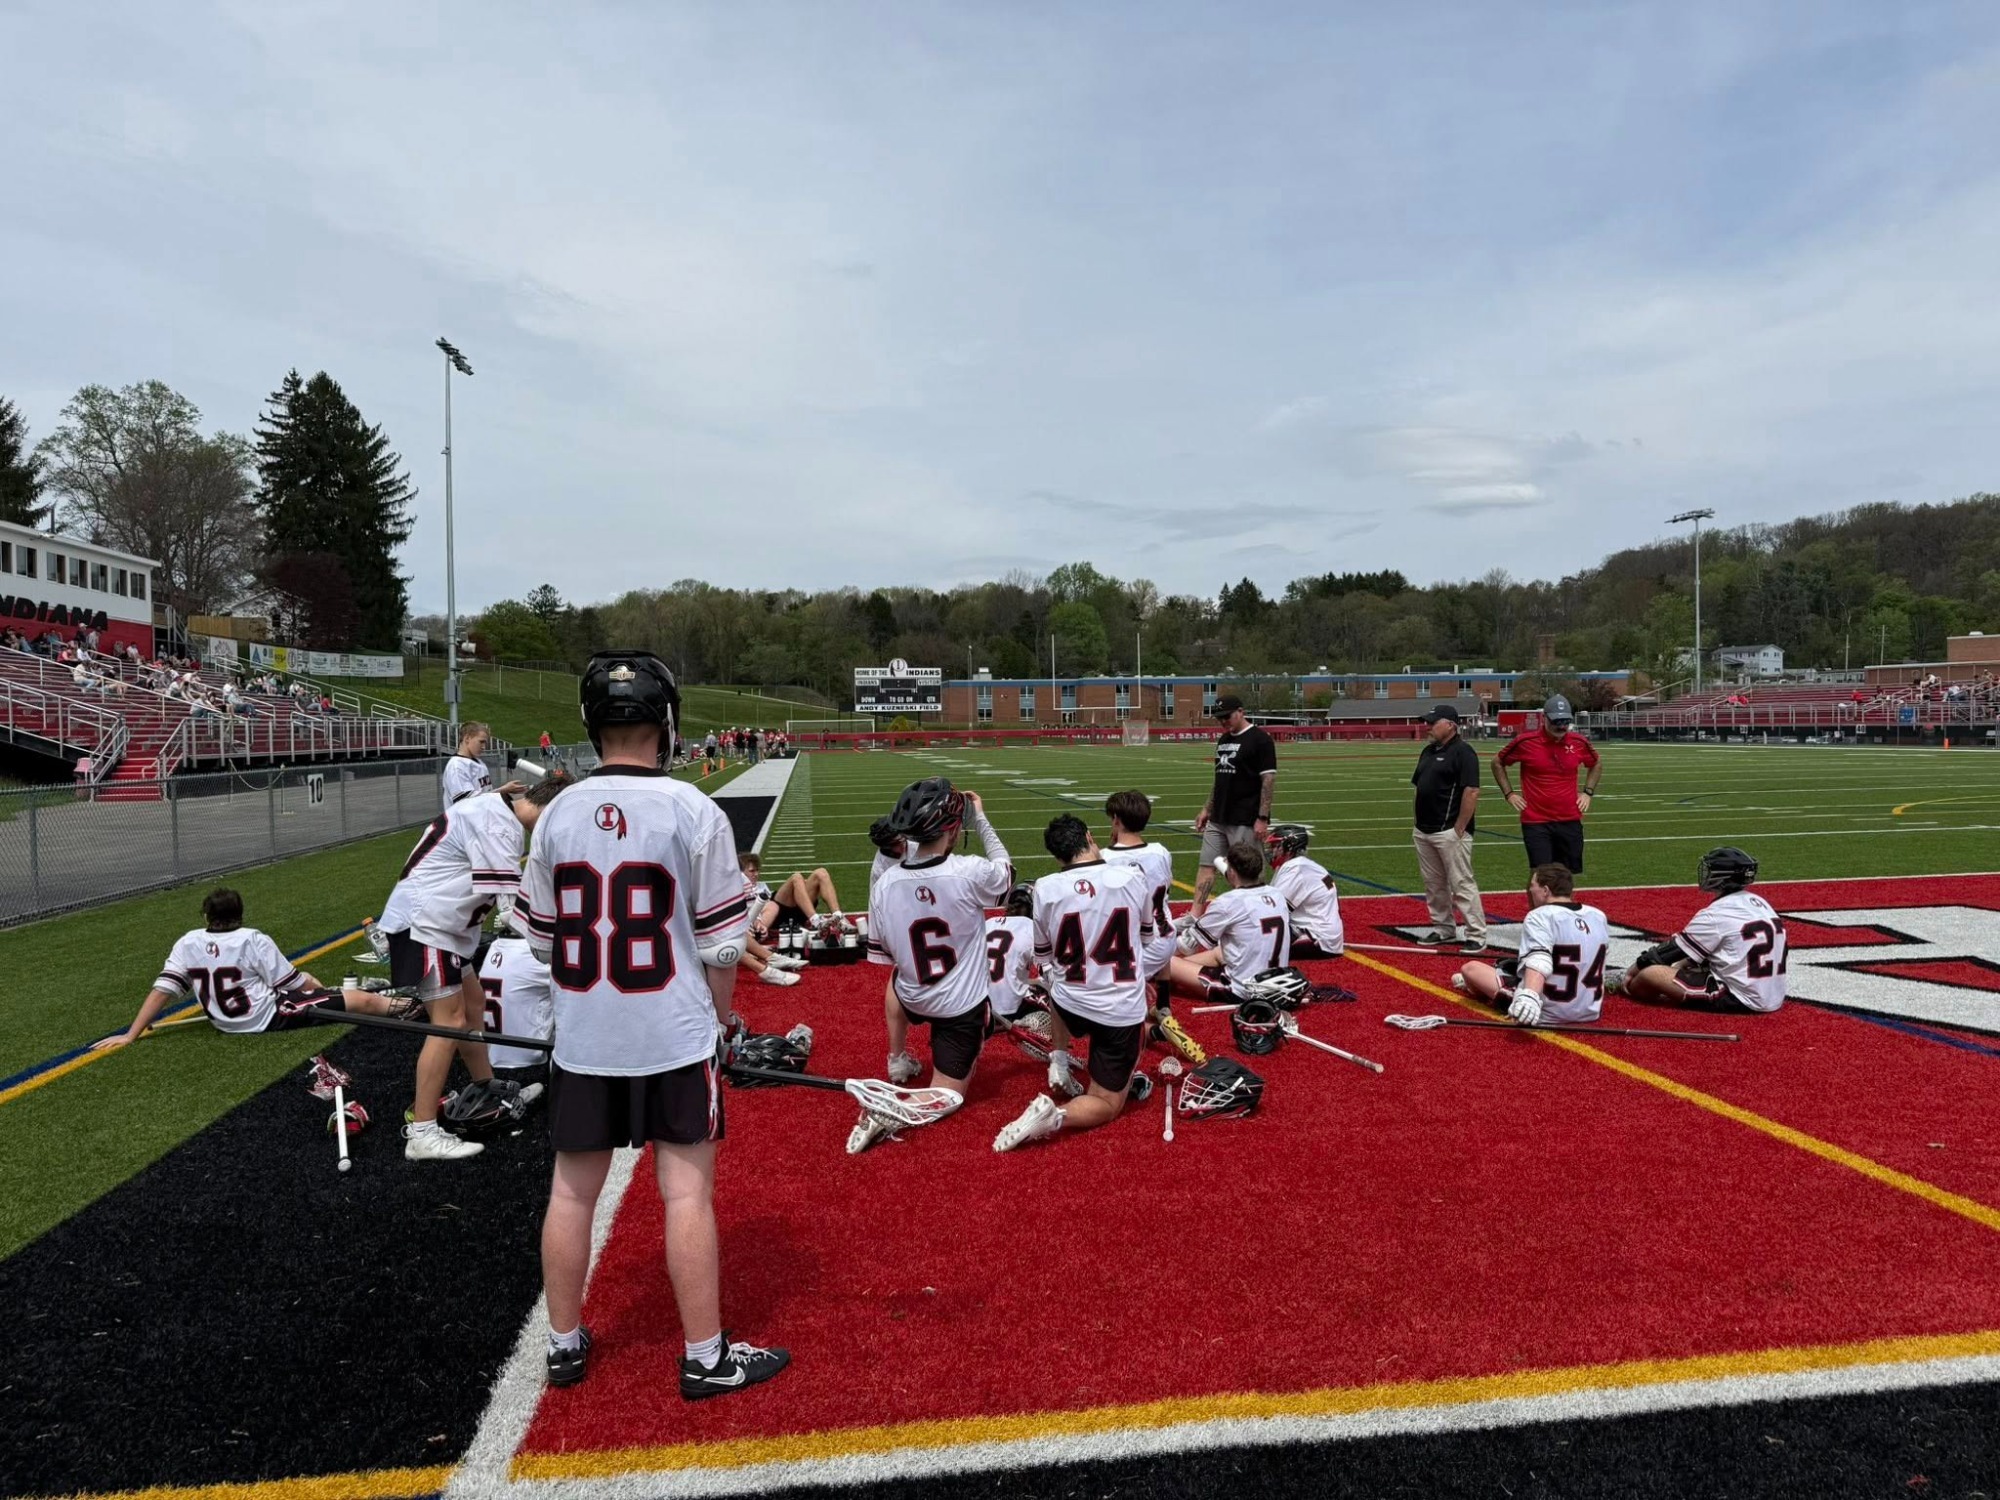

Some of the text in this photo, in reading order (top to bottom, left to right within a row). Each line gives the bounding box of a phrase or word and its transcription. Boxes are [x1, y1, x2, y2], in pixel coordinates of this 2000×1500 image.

[309, 777, 323, 803] 10
[551, 861, 676, 994] 88
[908, 917, 957, 985] 6
[1054, 907, 1137, 984] 44
[1259, 915, 1285, 968] 7
[1741, 917, 1788, 978] 27
[187, 966, 251, 1019] 76
[1543, 944, 1606, 1003] 54
